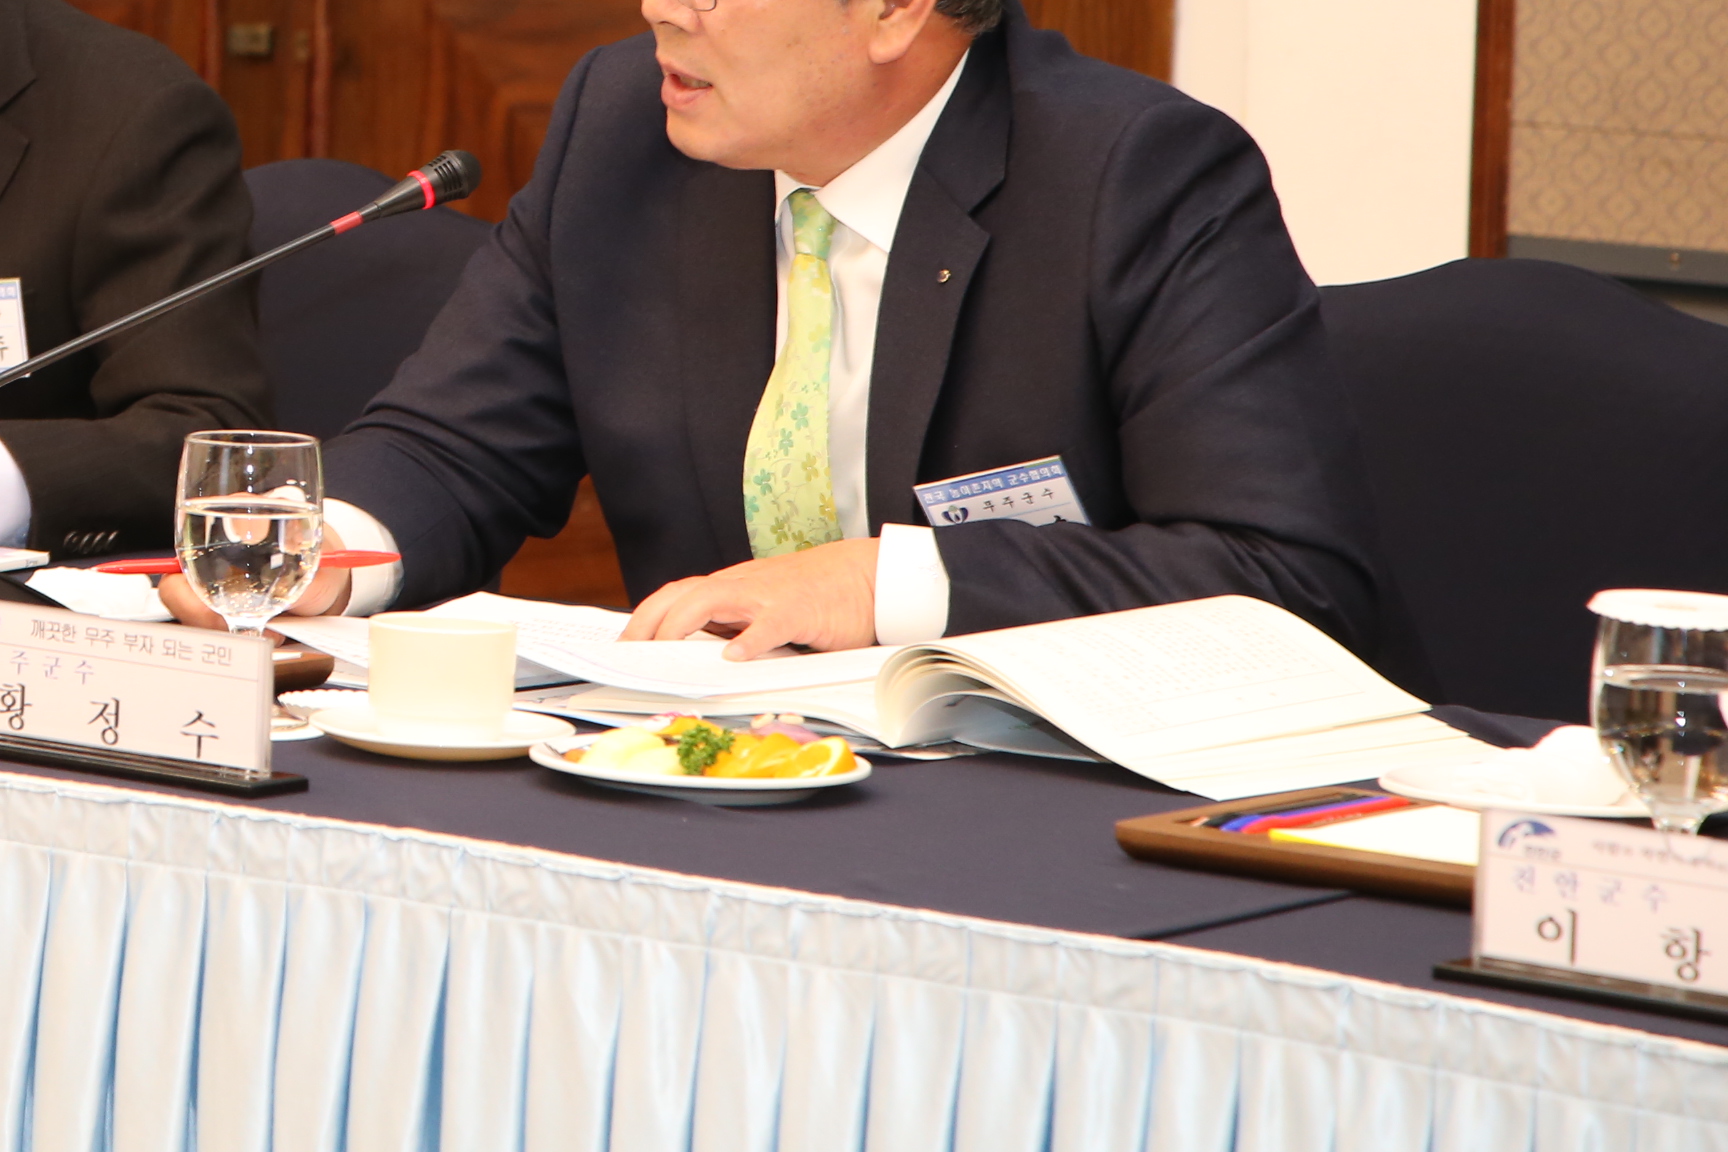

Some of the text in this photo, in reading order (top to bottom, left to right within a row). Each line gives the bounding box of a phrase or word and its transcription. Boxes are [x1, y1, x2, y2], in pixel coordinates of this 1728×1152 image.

[30, 618, 233, 667] 깨끗한 무주 부자 되는 군민
